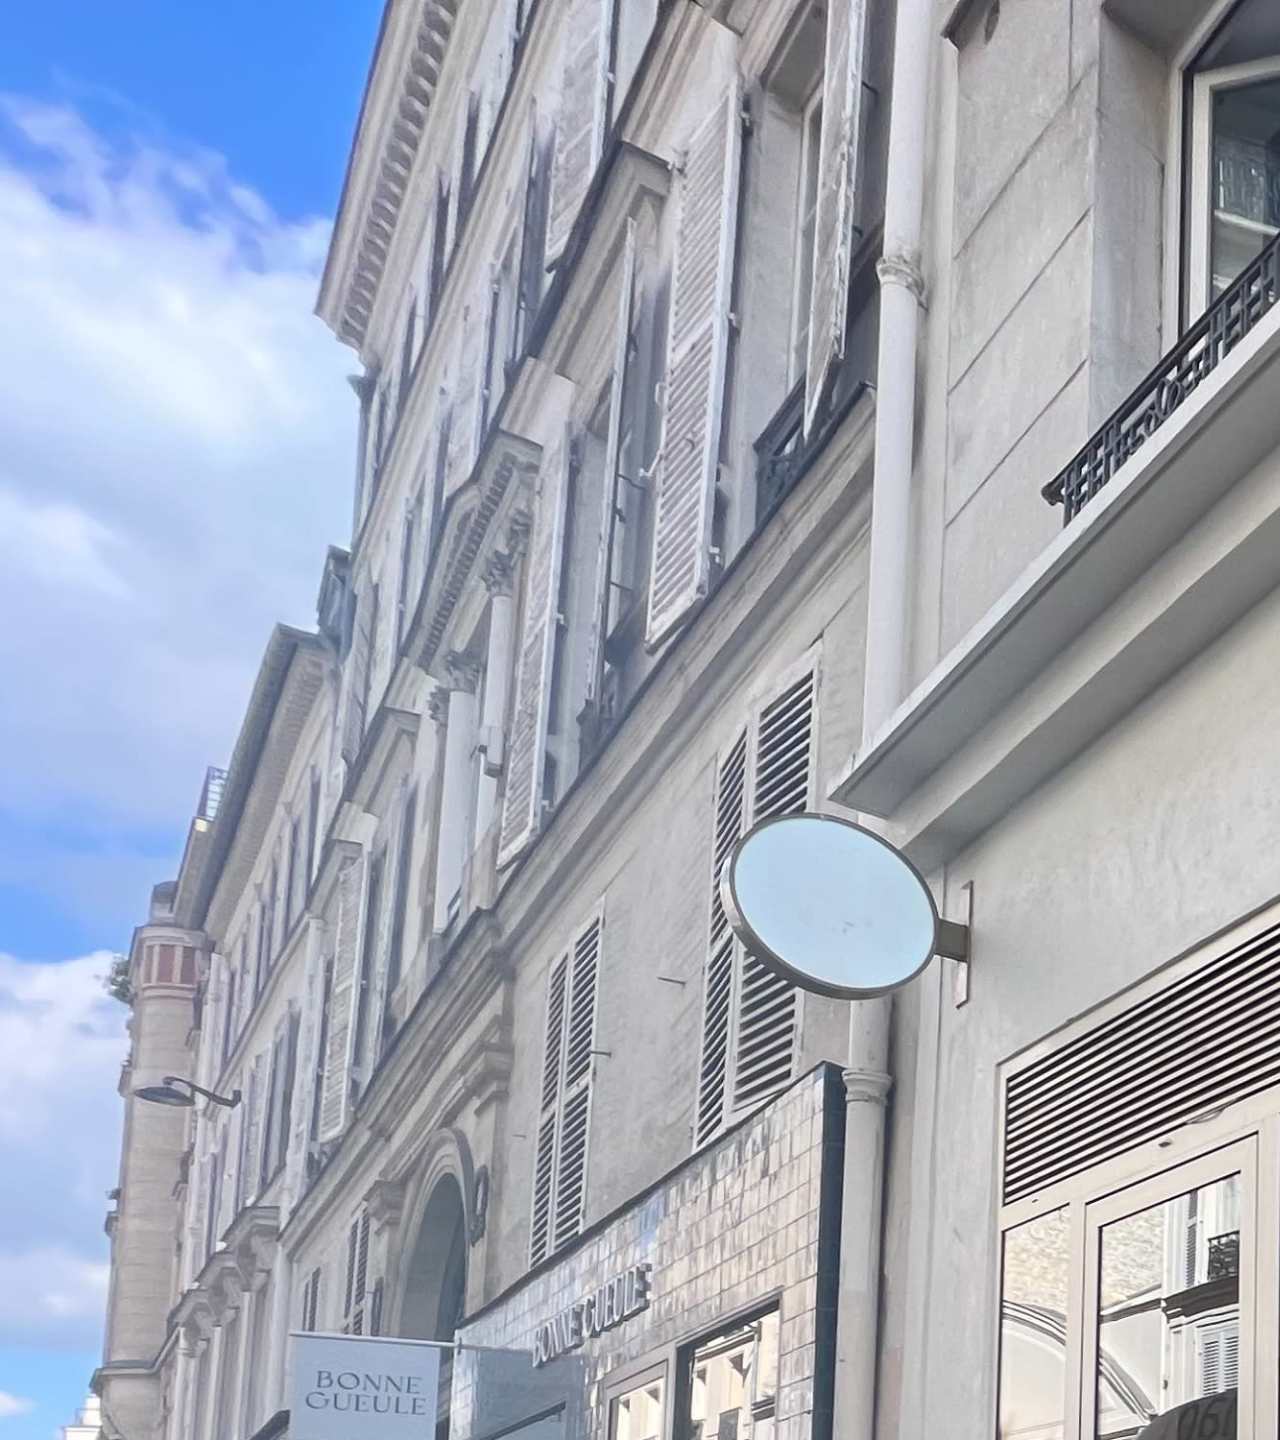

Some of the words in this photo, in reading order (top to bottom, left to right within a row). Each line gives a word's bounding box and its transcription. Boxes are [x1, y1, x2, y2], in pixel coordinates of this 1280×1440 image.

[532, 1303, 585, 1368] BONNE
[582, 1263, 653, 1338] GUEULE
[315, 1369, 423, 1394] BONNE
[305, 1391, 427, 1416] GUEULE
